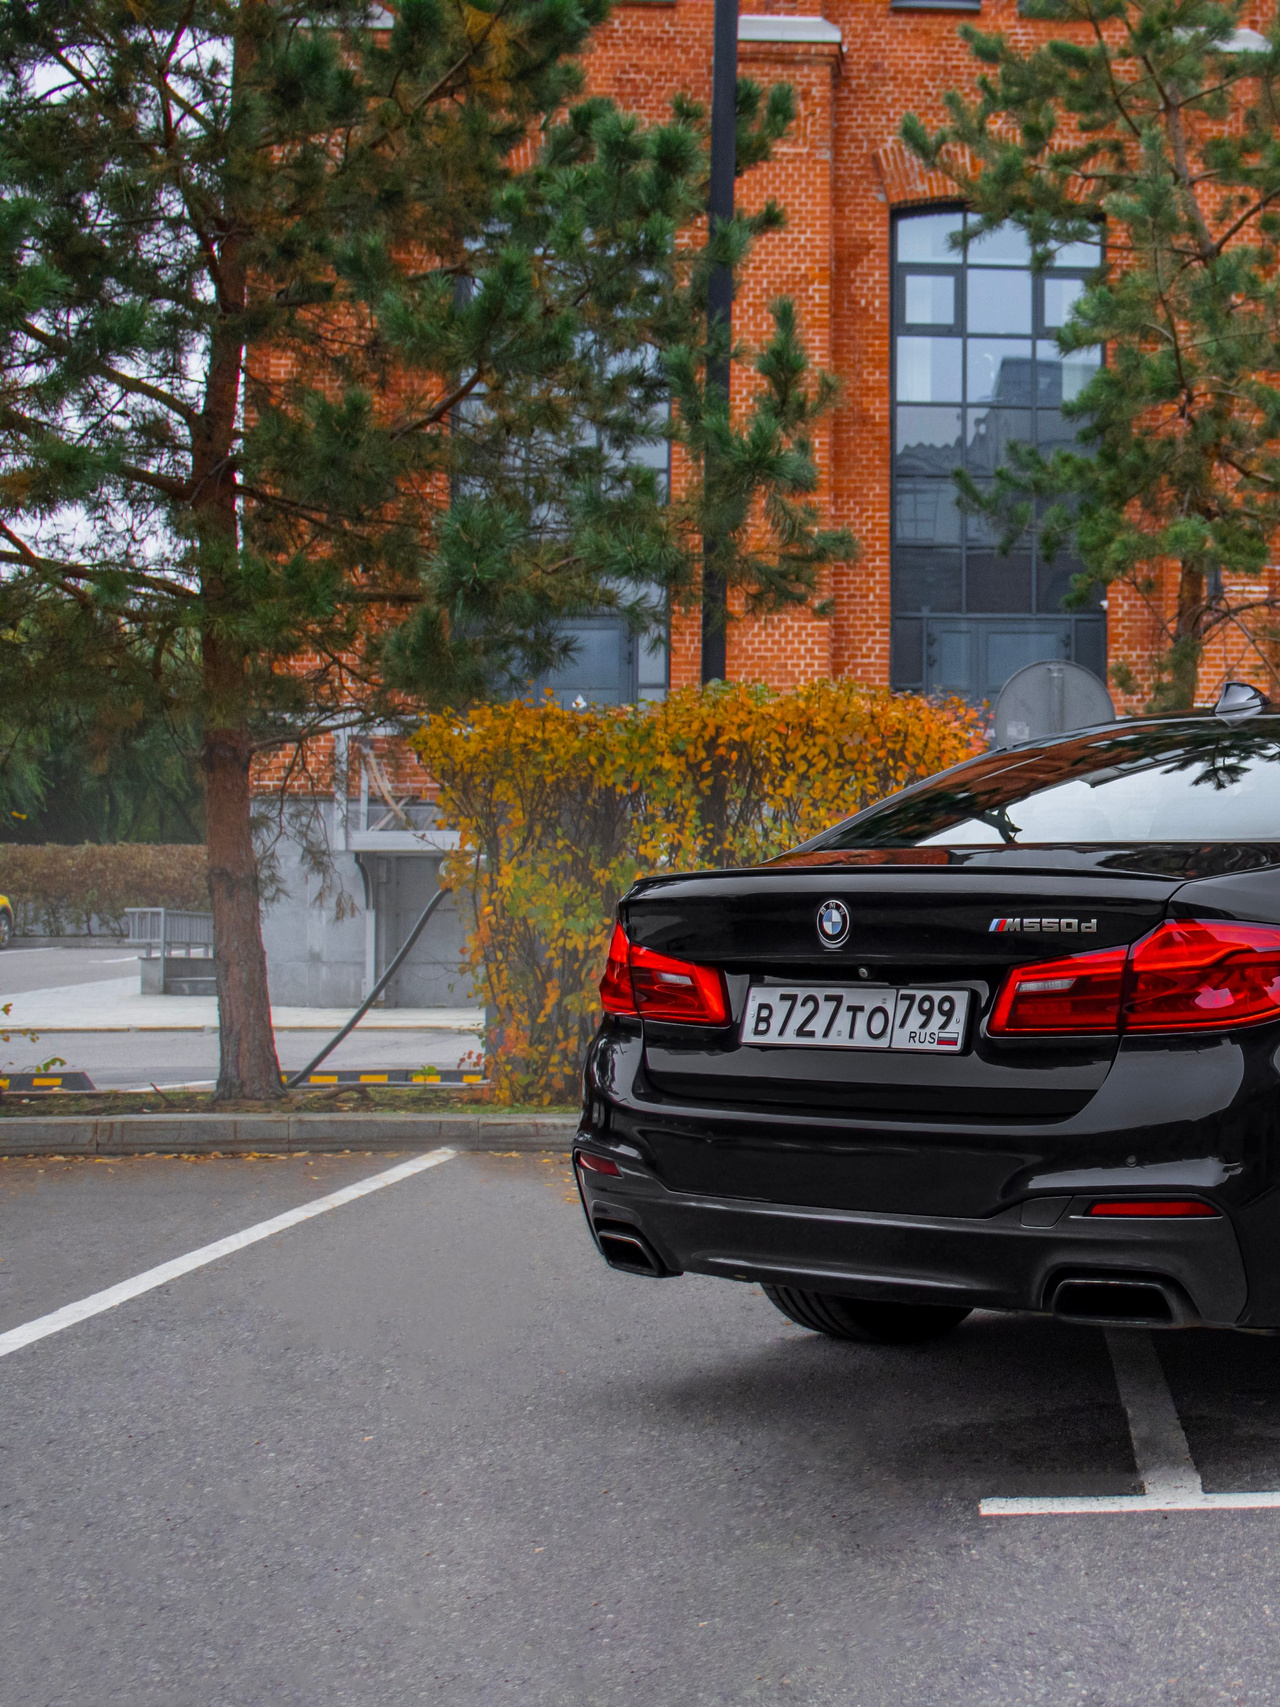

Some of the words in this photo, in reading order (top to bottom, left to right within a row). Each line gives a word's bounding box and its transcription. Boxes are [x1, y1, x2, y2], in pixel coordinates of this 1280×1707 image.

[1003, 918, 1098, 933] M550d
[898, 993, 956, 1030] 799
[908, 1031, 936, 1045] RUS
